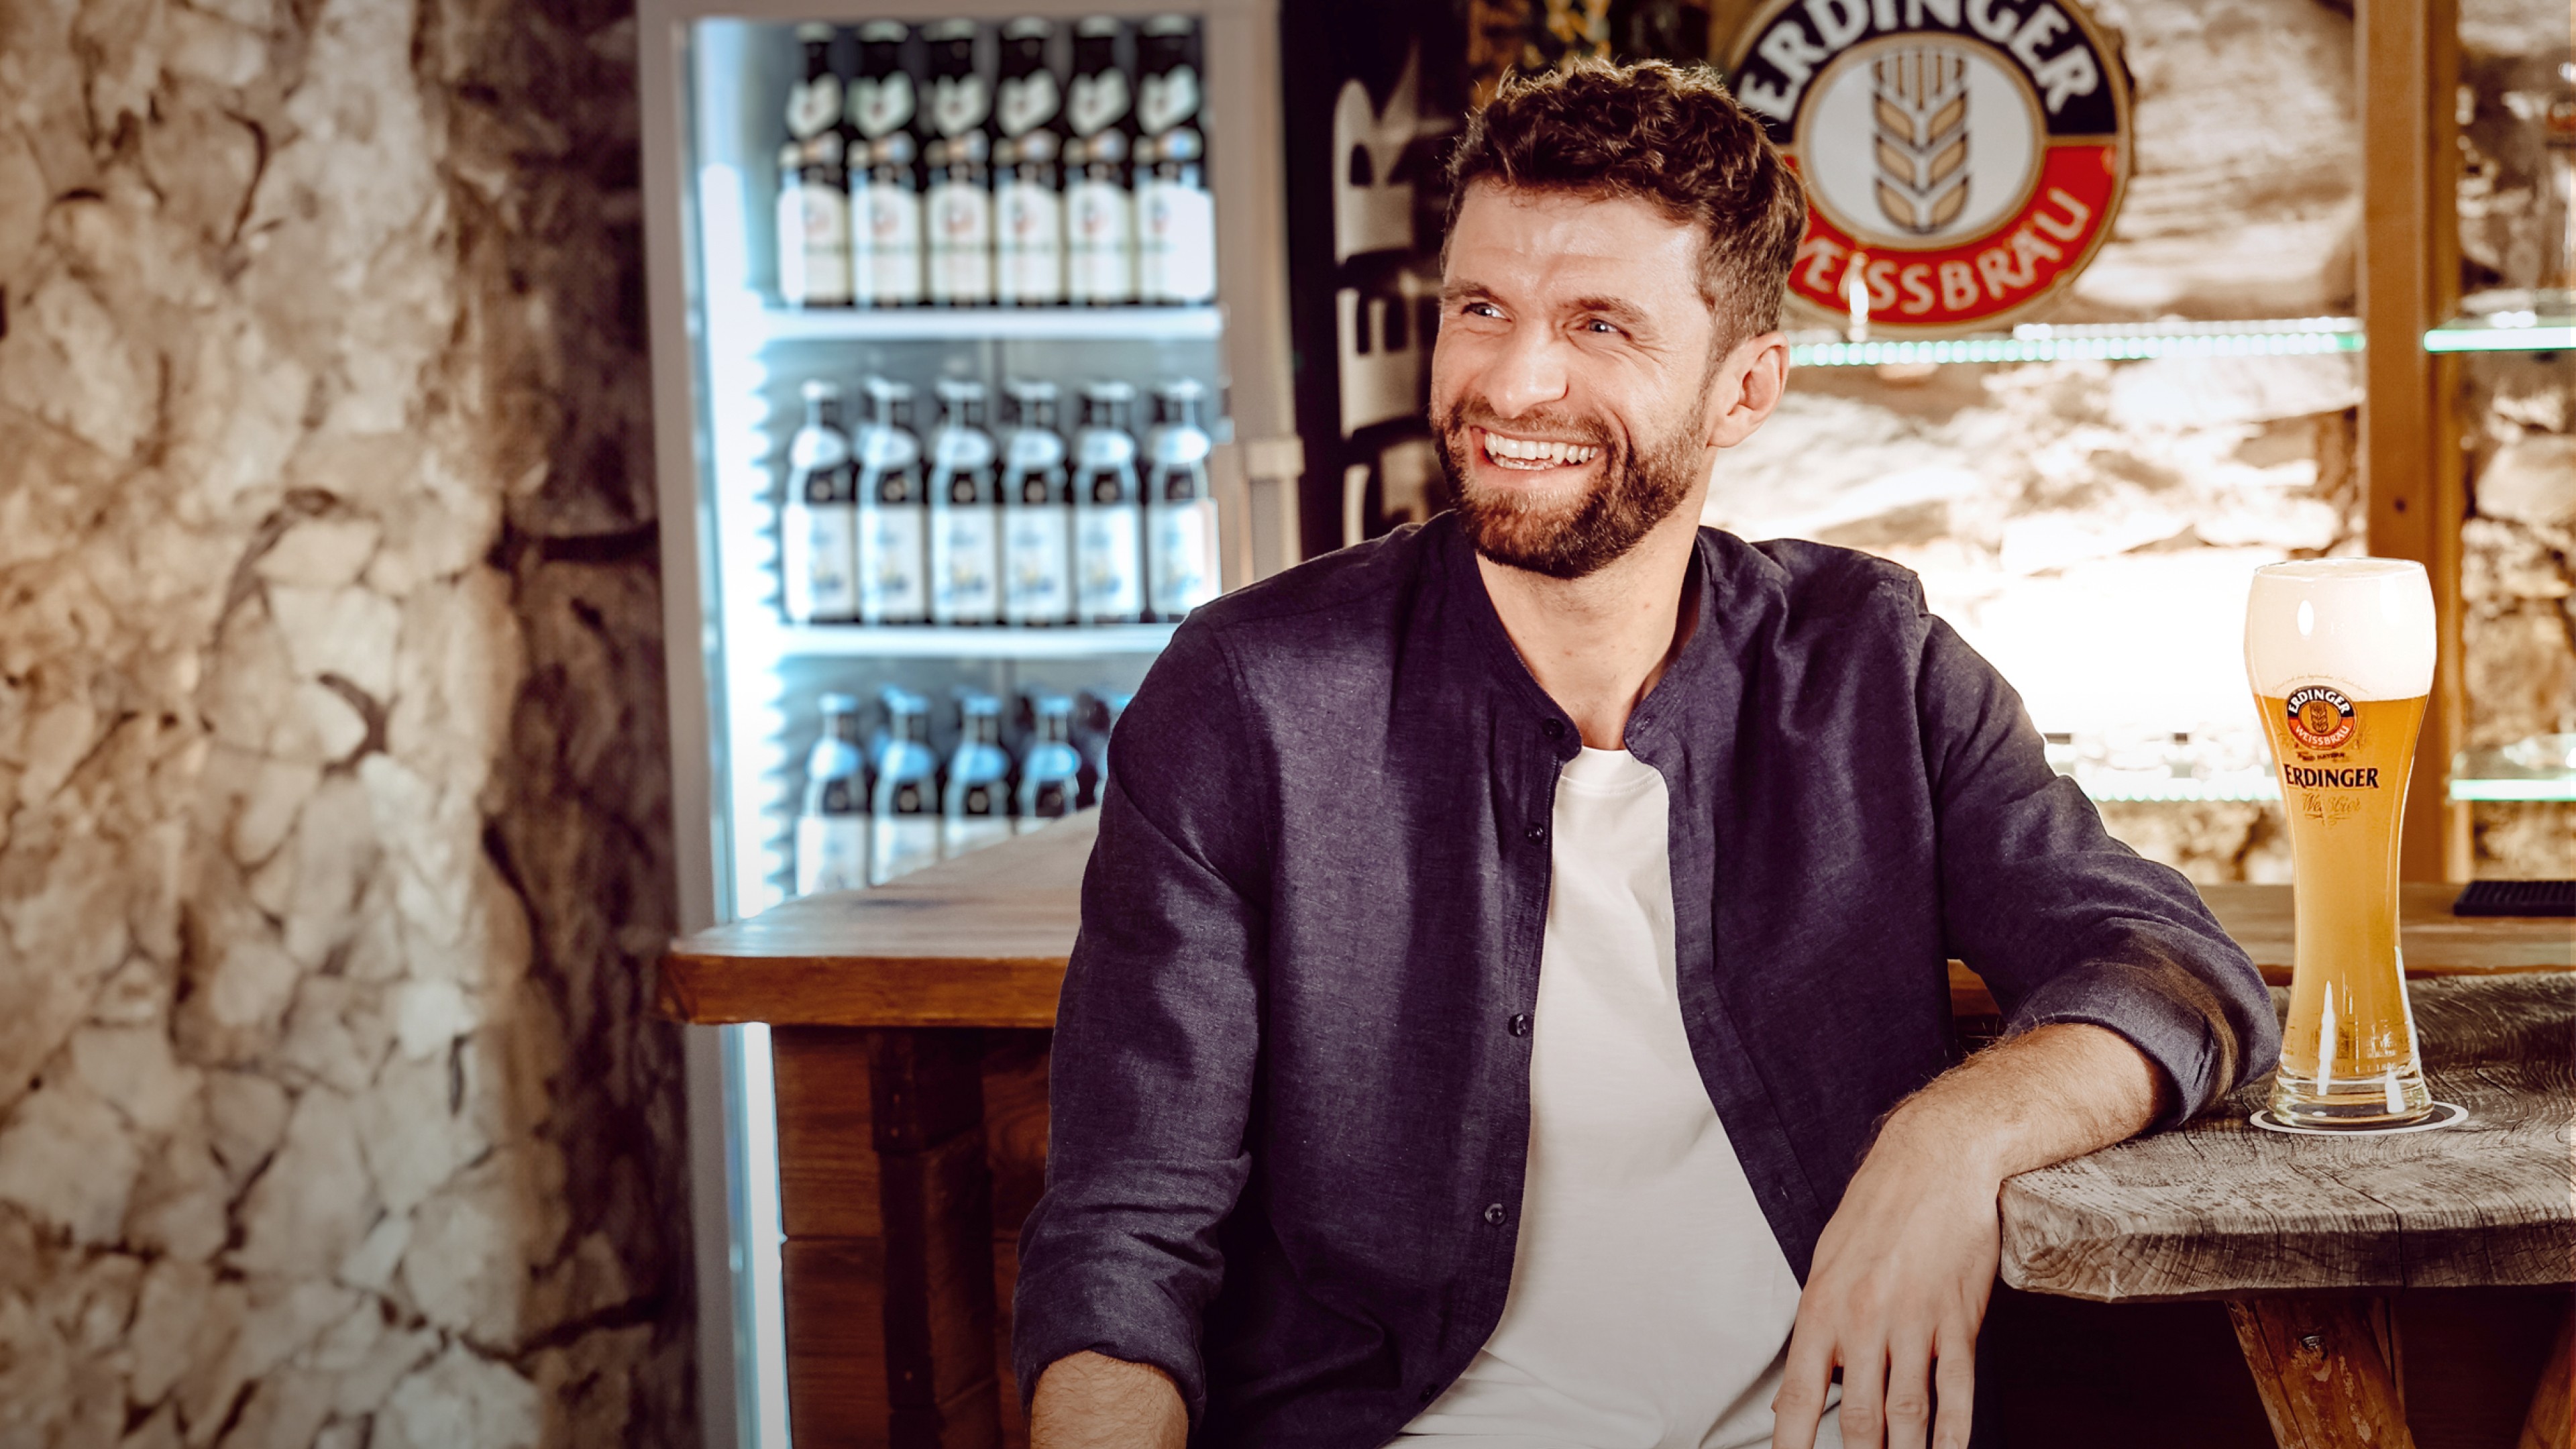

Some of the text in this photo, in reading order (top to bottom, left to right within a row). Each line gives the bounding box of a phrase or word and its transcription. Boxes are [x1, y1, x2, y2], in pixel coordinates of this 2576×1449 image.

[1738, 0, 2098, 122] ERDINGER
[2288, 688, 2351, 714] ERDINGER
[2284, 763, 2379, 789] ERDINGER
